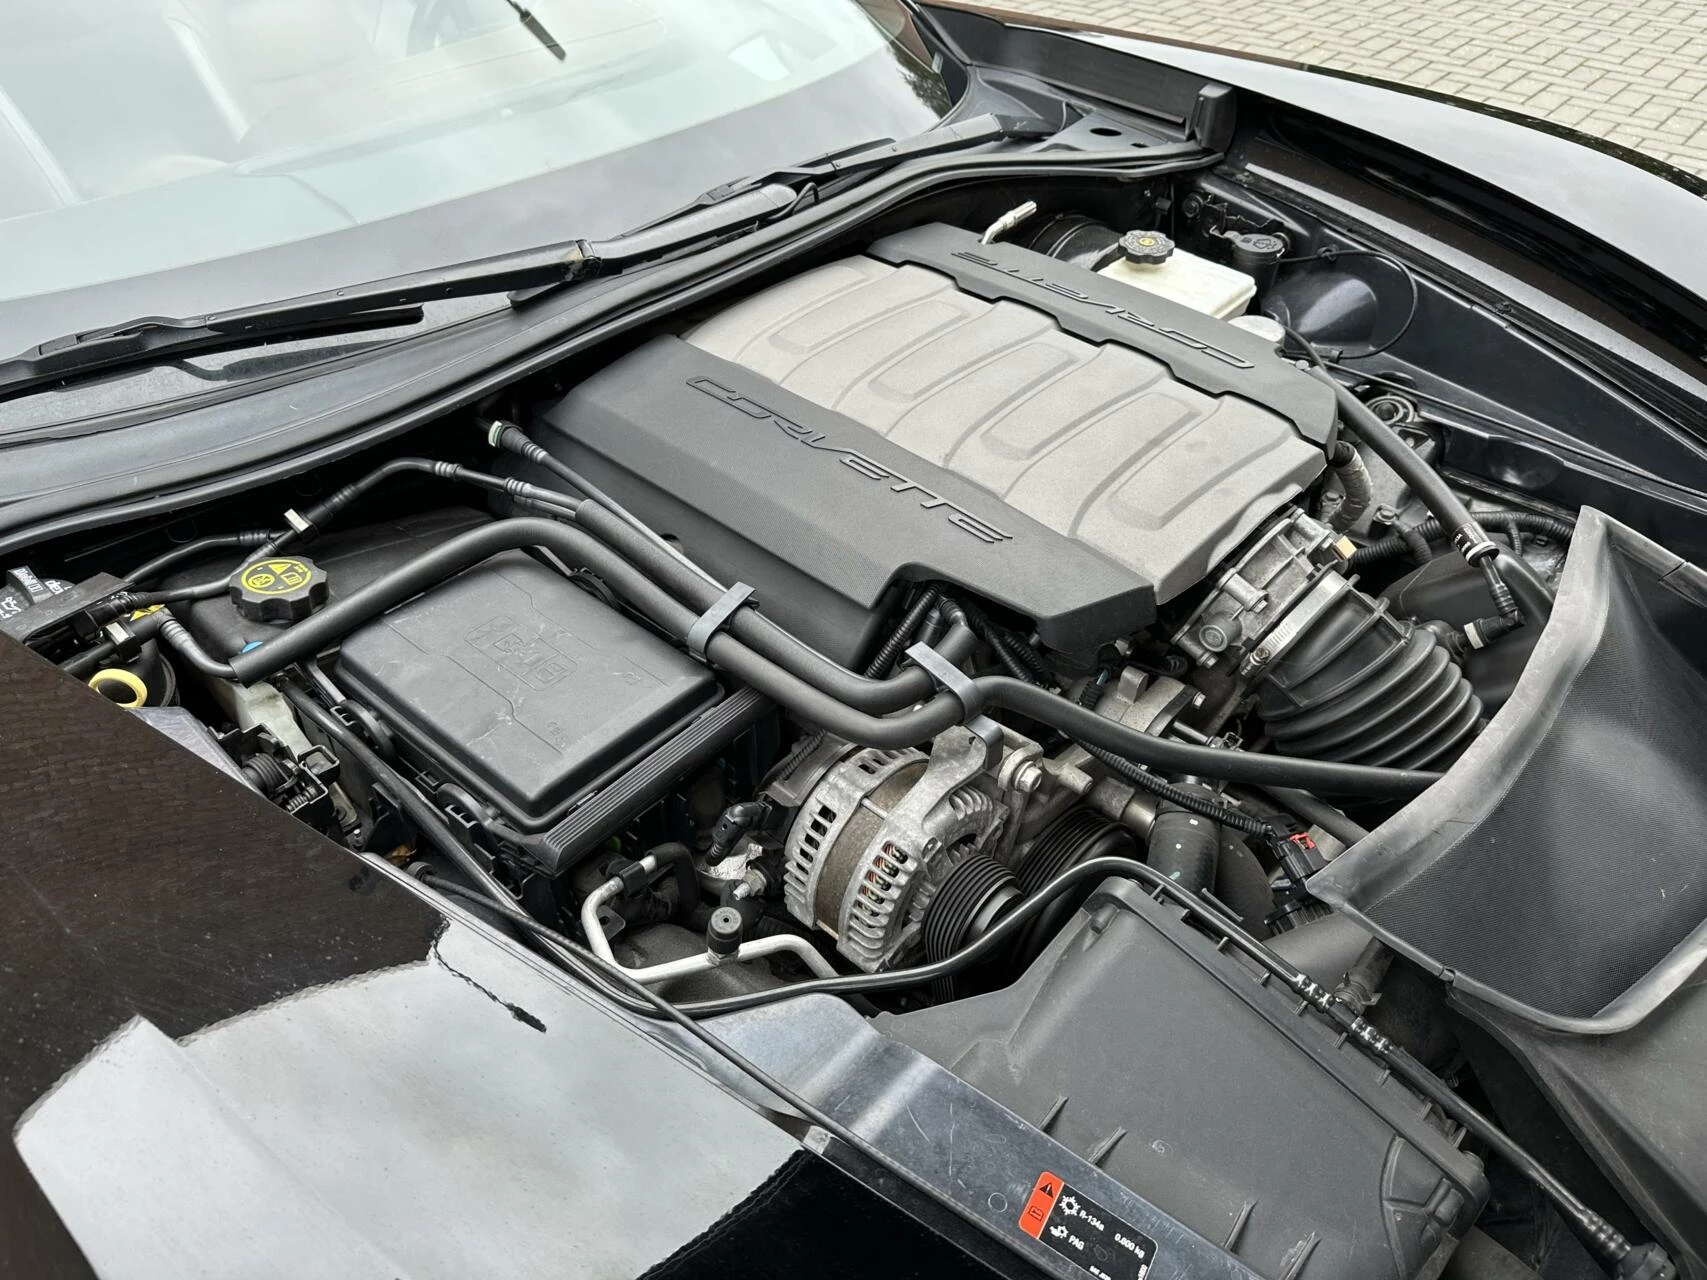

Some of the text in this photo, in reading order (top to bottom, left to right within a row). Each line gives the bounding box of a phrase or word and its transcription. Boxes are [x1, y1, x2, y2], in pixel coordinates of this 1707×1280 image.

[950, 250, 1256, 369] CORVETTE
[685, 375, 1014, 544] CORVETTE
[1068, 1235, 1085, 1251] PAG
[1079, 1209, 1105, 1231] R-134a
[1134, 1246, 1145, 1259] kg
